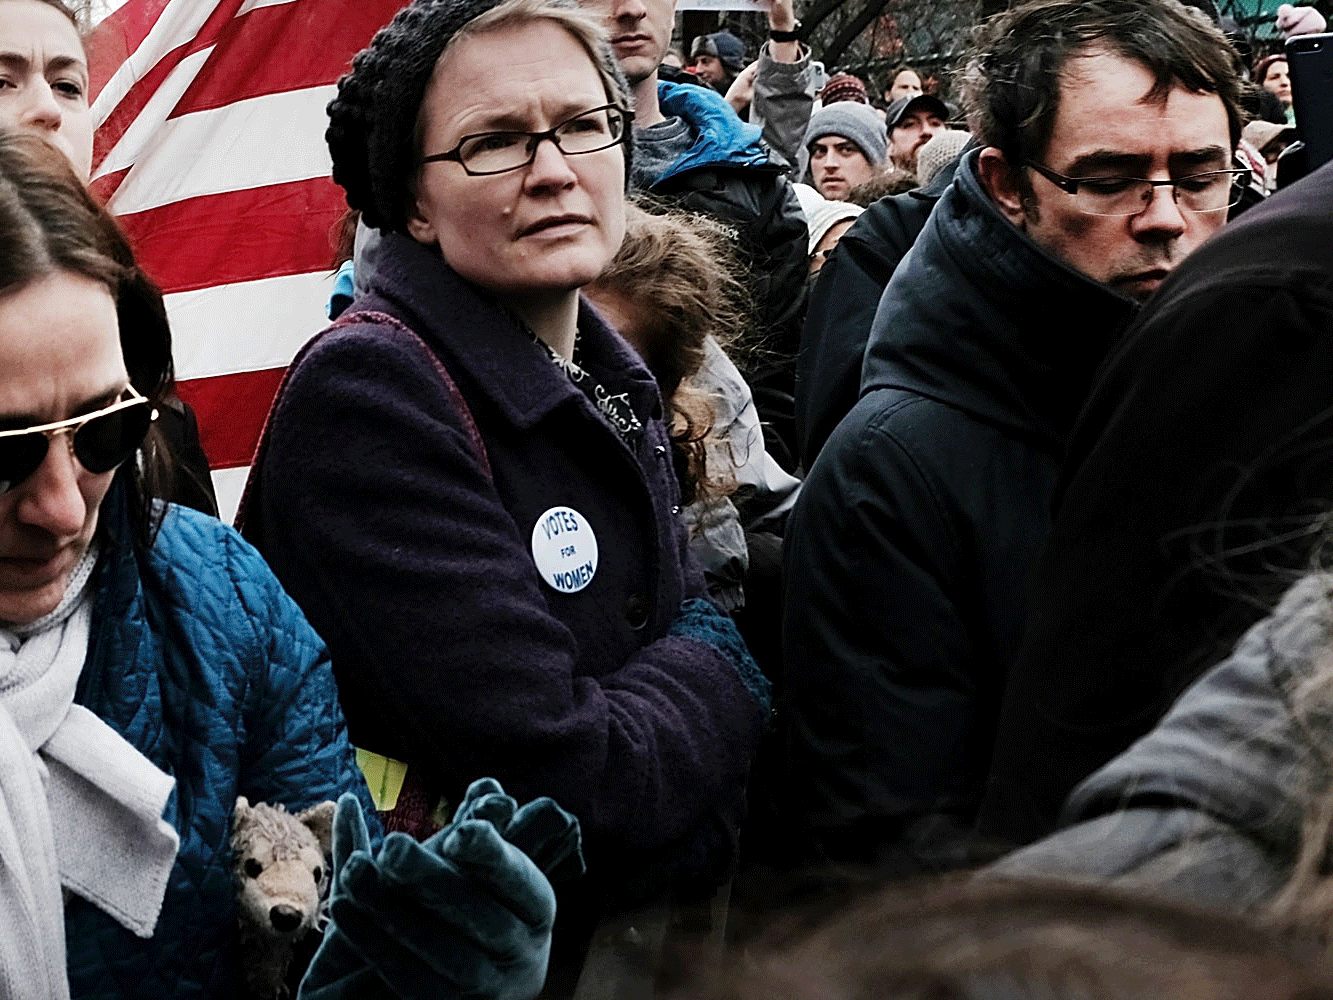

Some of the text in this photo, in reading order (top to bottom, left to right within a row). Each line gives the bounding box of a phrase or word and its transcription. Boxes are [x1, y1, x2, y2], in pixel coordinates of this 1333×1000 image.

[541, 511, 579, 540] VOTES
[560, 545, 576, 559] FOR
[552, 560, 594, 590] WOMEN
